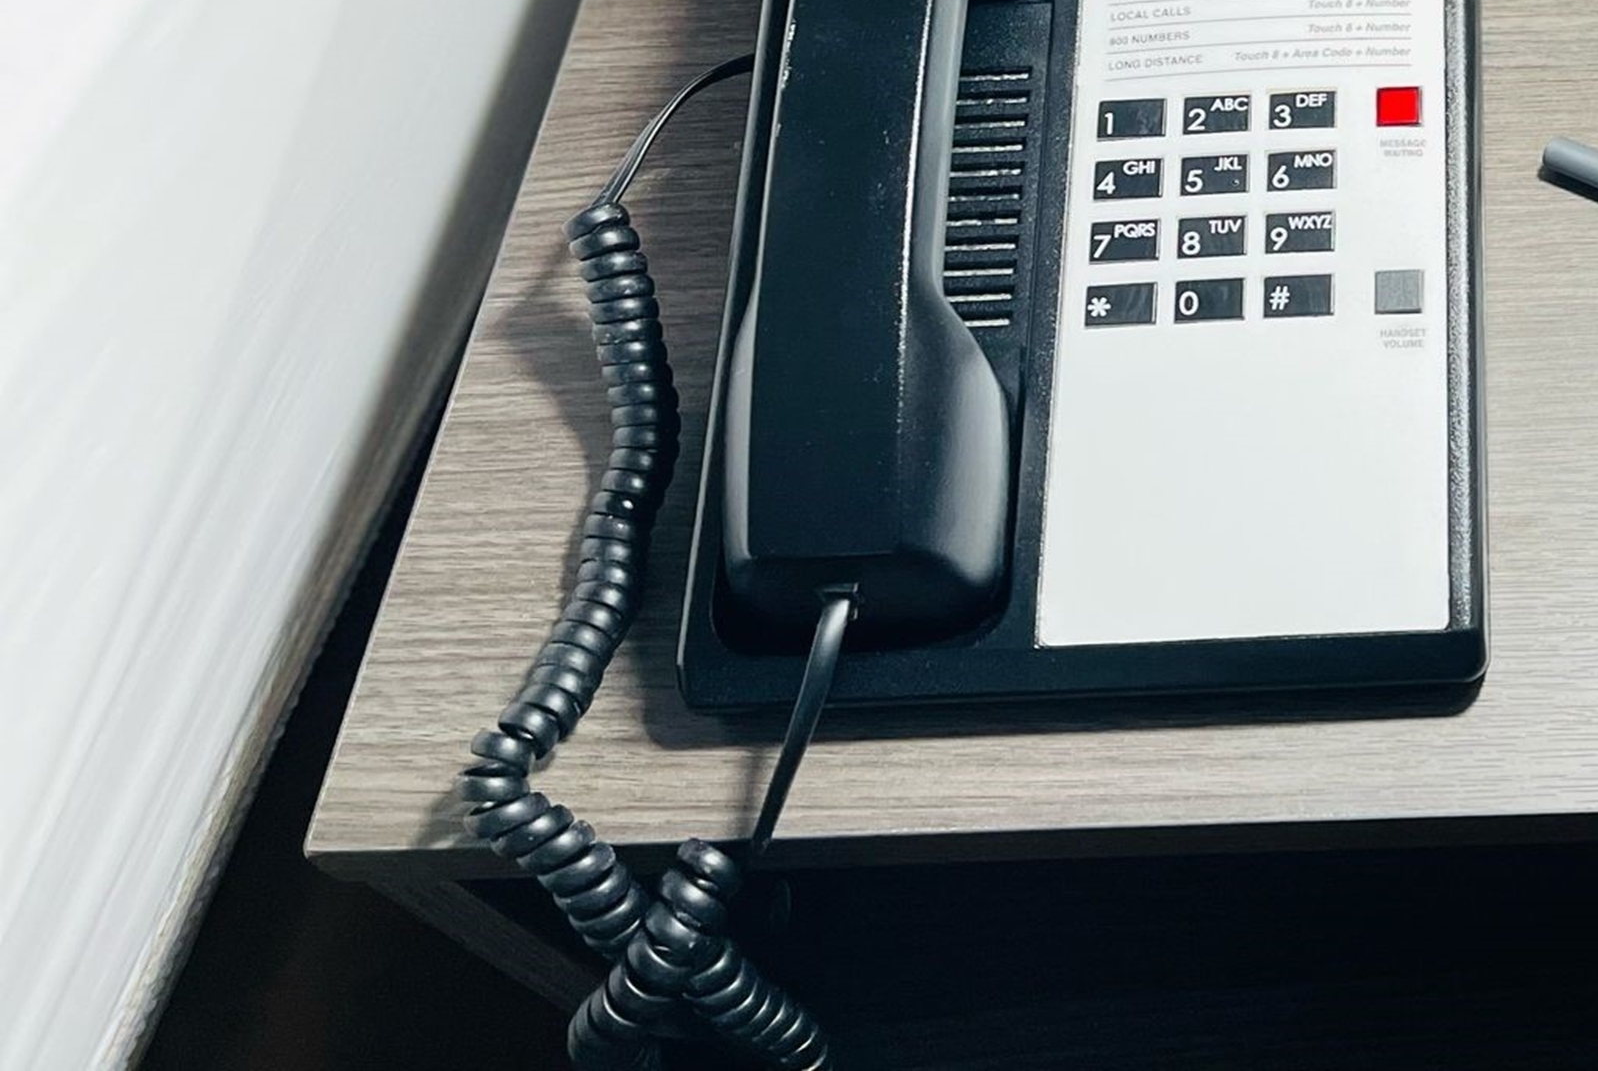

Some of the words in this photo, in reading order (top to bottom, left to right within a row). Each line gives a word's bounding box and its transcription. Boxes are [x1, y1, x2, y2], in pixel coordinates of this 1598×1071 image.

[1110, 10, 1150, 22] LOCAL
[1152, 6, 1192, 18] CALLS
[1132, 30, 1191, 44] NUMBERS
[1308, 23, 1343, 34] Touch
[1364, 22, 1412, 33] Number
[1108, 59, 1141, 71] LONG
[1144, 54, 1204, 68] DISTANCE
[1234, 50, 1269, 61] Touch
[1291, 47, 1319, 59] Area
[1322, 46, 1353, 58] Code
[1364, 45, 1412, 57] Number
[1210, 96, 1249, 112] ABC
[1295, 93, 1328, 109] DEF
[1103, 112, 1114, 135] 1
[1187, 109, 1206, 131] 2
[1273, 104, 1292, 128] 3
[1122, 159, 1156, 175] GHI
[1214, 156, 1242, 172] JKL
[1294, 152, 1332, 168] MNO
[1096, 172, 1116, 195] 4
[1184, 170, 1203, 192] 5
[1272, 165, 1290, 189] 6
[1113, 222, 1156, 239] PQRS
[1208, 219, 1242, 235] TUV
[1288, 214, 1332, 230] WXYZ
[1093, 235, 1112, 259] 7
[1181, 232, 1200, 255] 8
[1269, 227, 1288, 251] 9
[1178, 292, 1198, 316] 0
[1382, 338, 1425, 349] VOLUME
